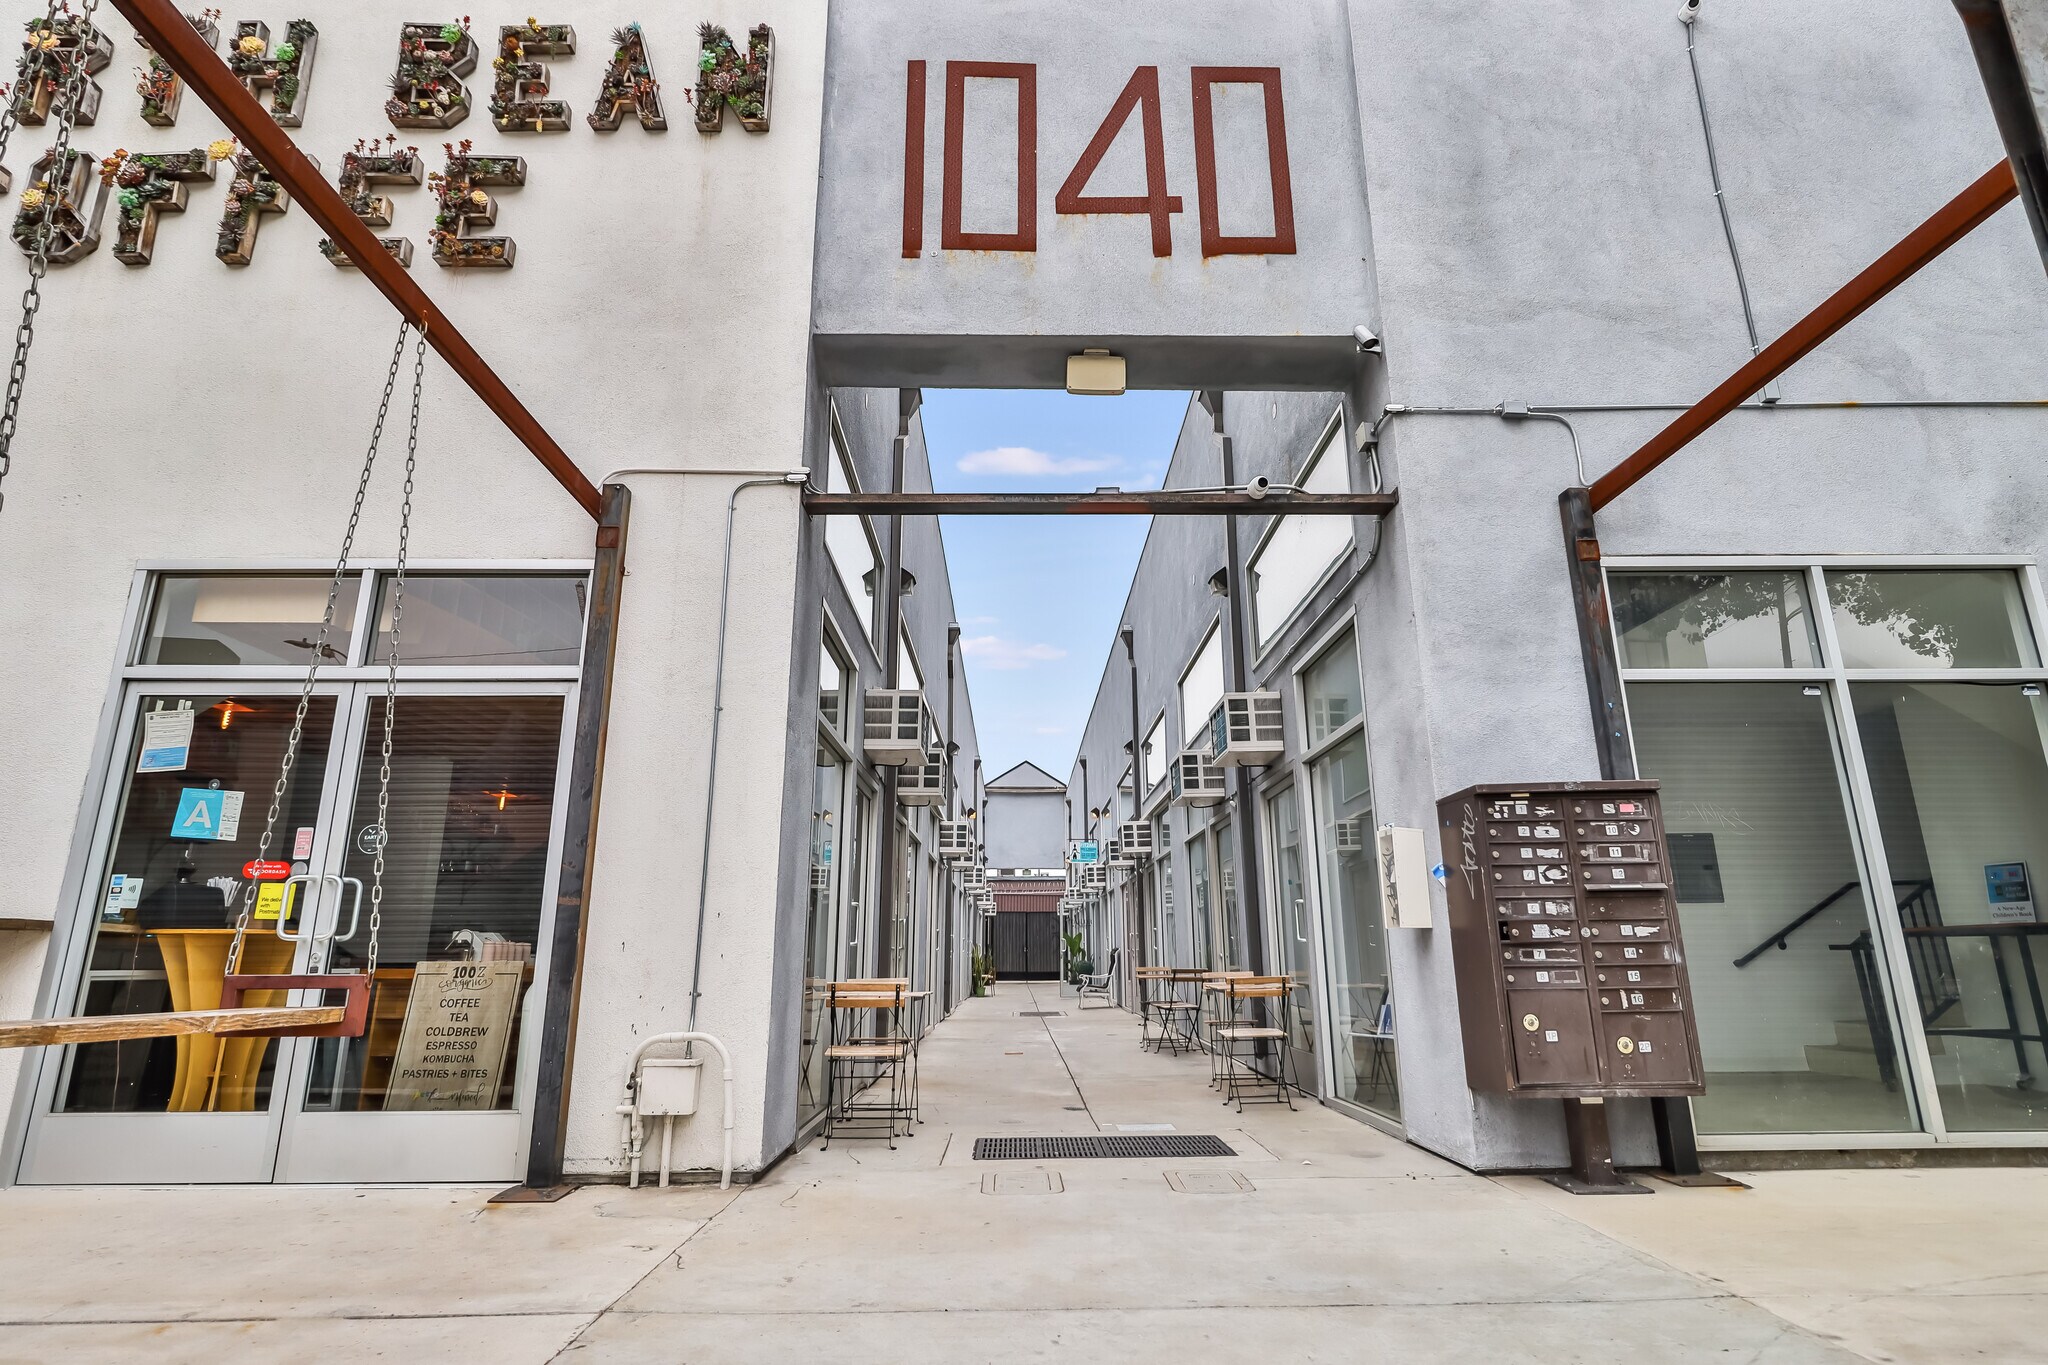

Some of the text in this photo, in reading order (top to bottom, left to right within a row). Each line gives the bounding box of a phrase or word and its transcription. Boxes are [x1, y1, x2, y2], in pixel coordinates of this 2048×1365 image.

[386, 18, 775, 132] BEAN
[902, 59, 1297, 259] 1040
[0, 146, 527, 267] OFFEE
[182, 799, 212, 829] A
[1607, 826, 1617, 834] 10
[1611, 848, 1620, 856] 11
[1536, 950, 1542, 958] 7
[1625, 949, 1636, 957] 14
[1629, 972, 1639, 980] 15
[439, 998, 481, 1008] COFFEE
[1632, 995, 1643, 1003] 16
[449, 1012, 469, 1022] TEA
[425, 1026, 489, 1037] COLDBREW
[425, 1041, 478, 1050] ESPRESSO
[422, 1054, 475, 1064] KOMBUCHA
[401, 1069, 450, 1079] PASTRIES
[460, 1069, 488, 1078] BITES
